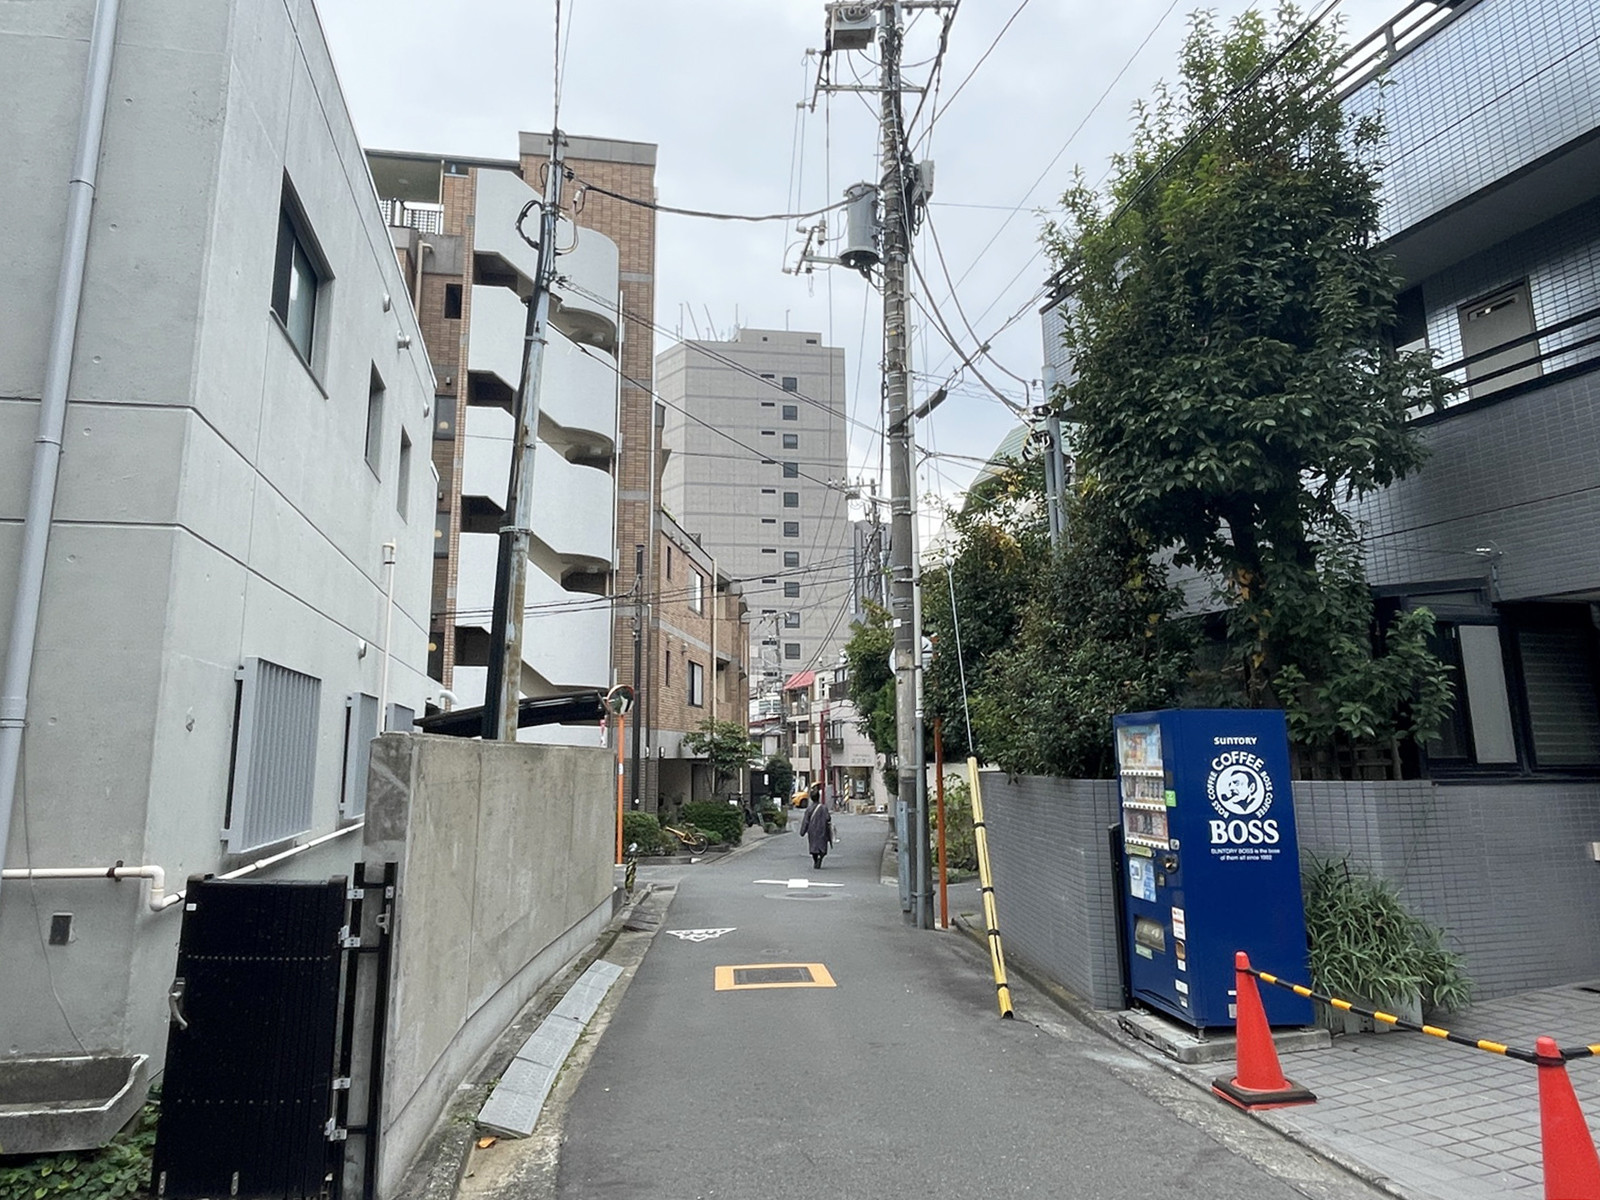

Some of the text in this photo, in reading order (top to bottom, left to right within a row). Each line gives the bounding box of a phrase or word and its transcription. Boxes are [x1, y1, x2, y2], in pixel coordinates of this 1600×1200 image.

[1214, 737, 1257, 745] SUNTORY
[1212, 751, 1264, 771] COFFEE
[1207, 771, 1230, 819] BOSS COFFEE
[1255, 770, 1273, 819] BOSS COFFEE
[1209, 820, 1279, 844] BOSS
